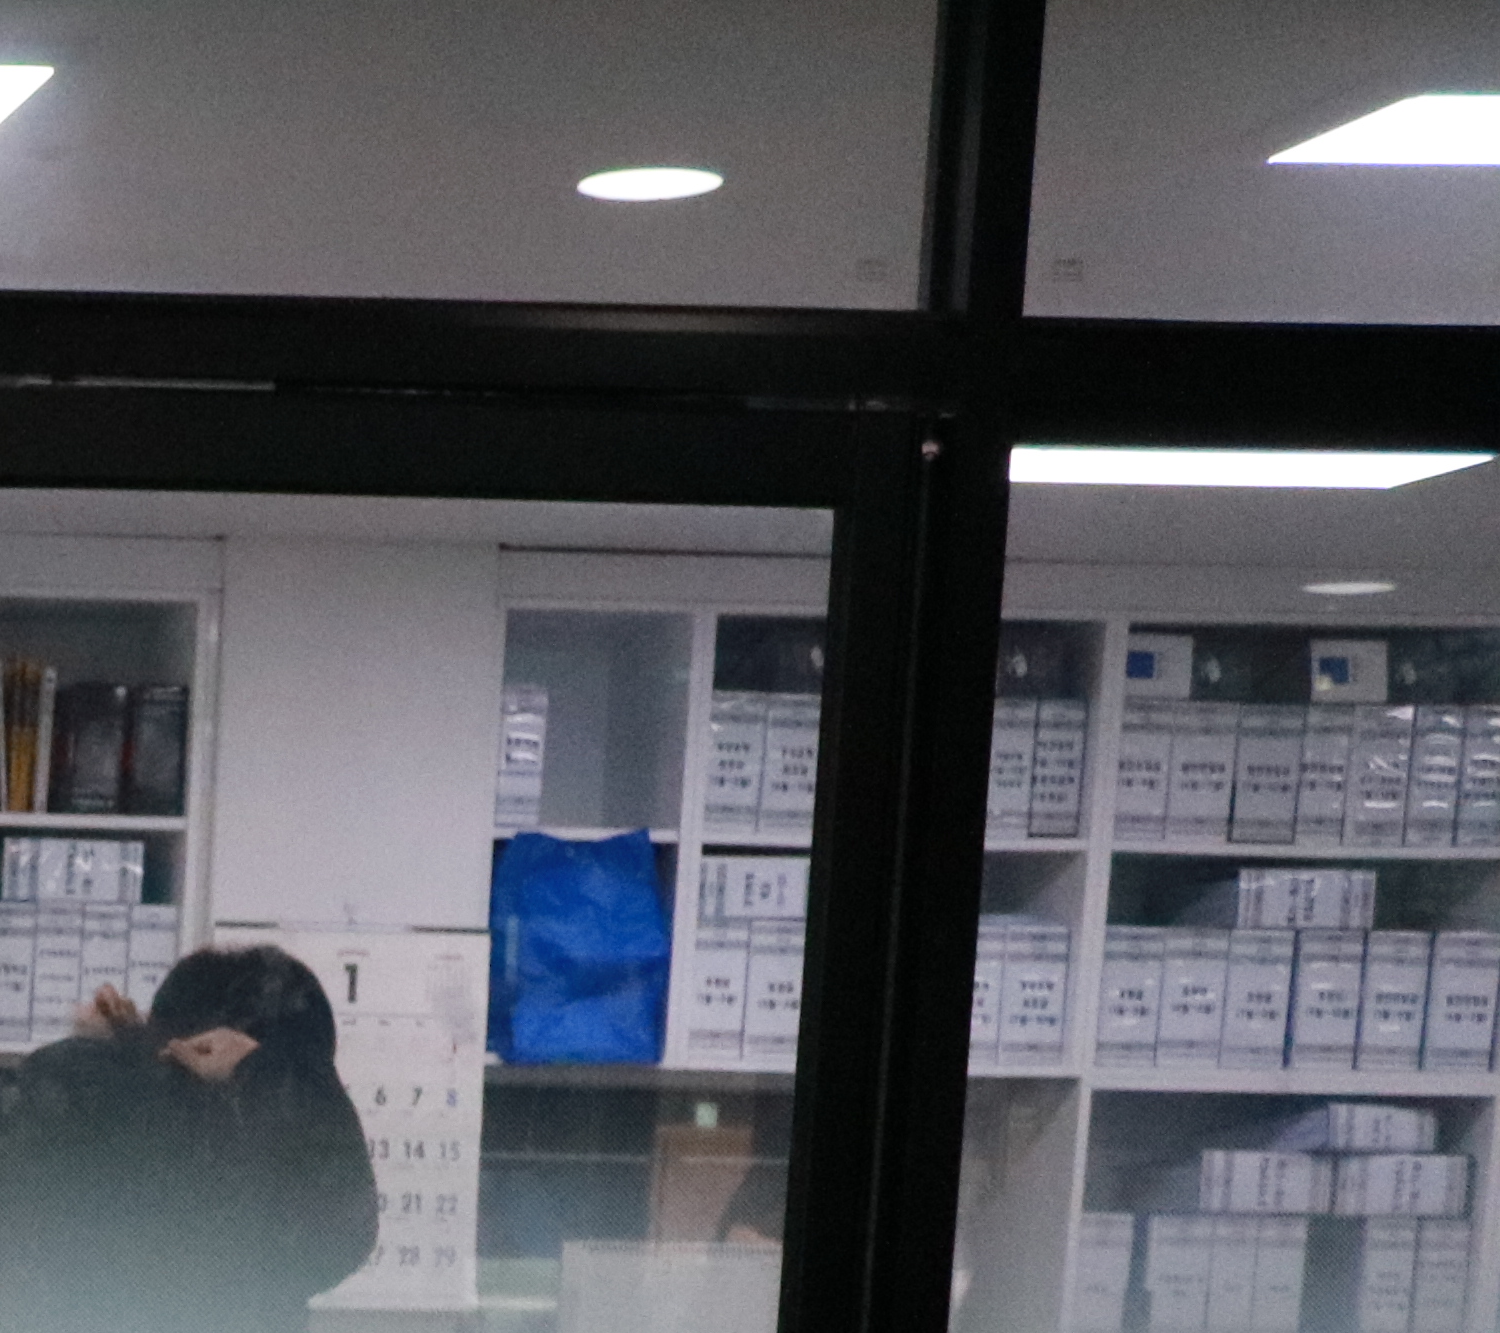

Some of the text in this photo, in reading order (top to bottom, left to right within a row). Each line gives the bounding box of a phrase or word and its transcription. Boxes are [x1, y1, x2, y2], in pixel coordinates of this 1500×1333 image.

[343, 963, 359, 1004] 1
[375, 1087, 387, 1106] 6
[411, 1086, 424, 1106] 7
[404, 1140, 425, 1161] 14
[438, 1141, 461, 1162] 15
